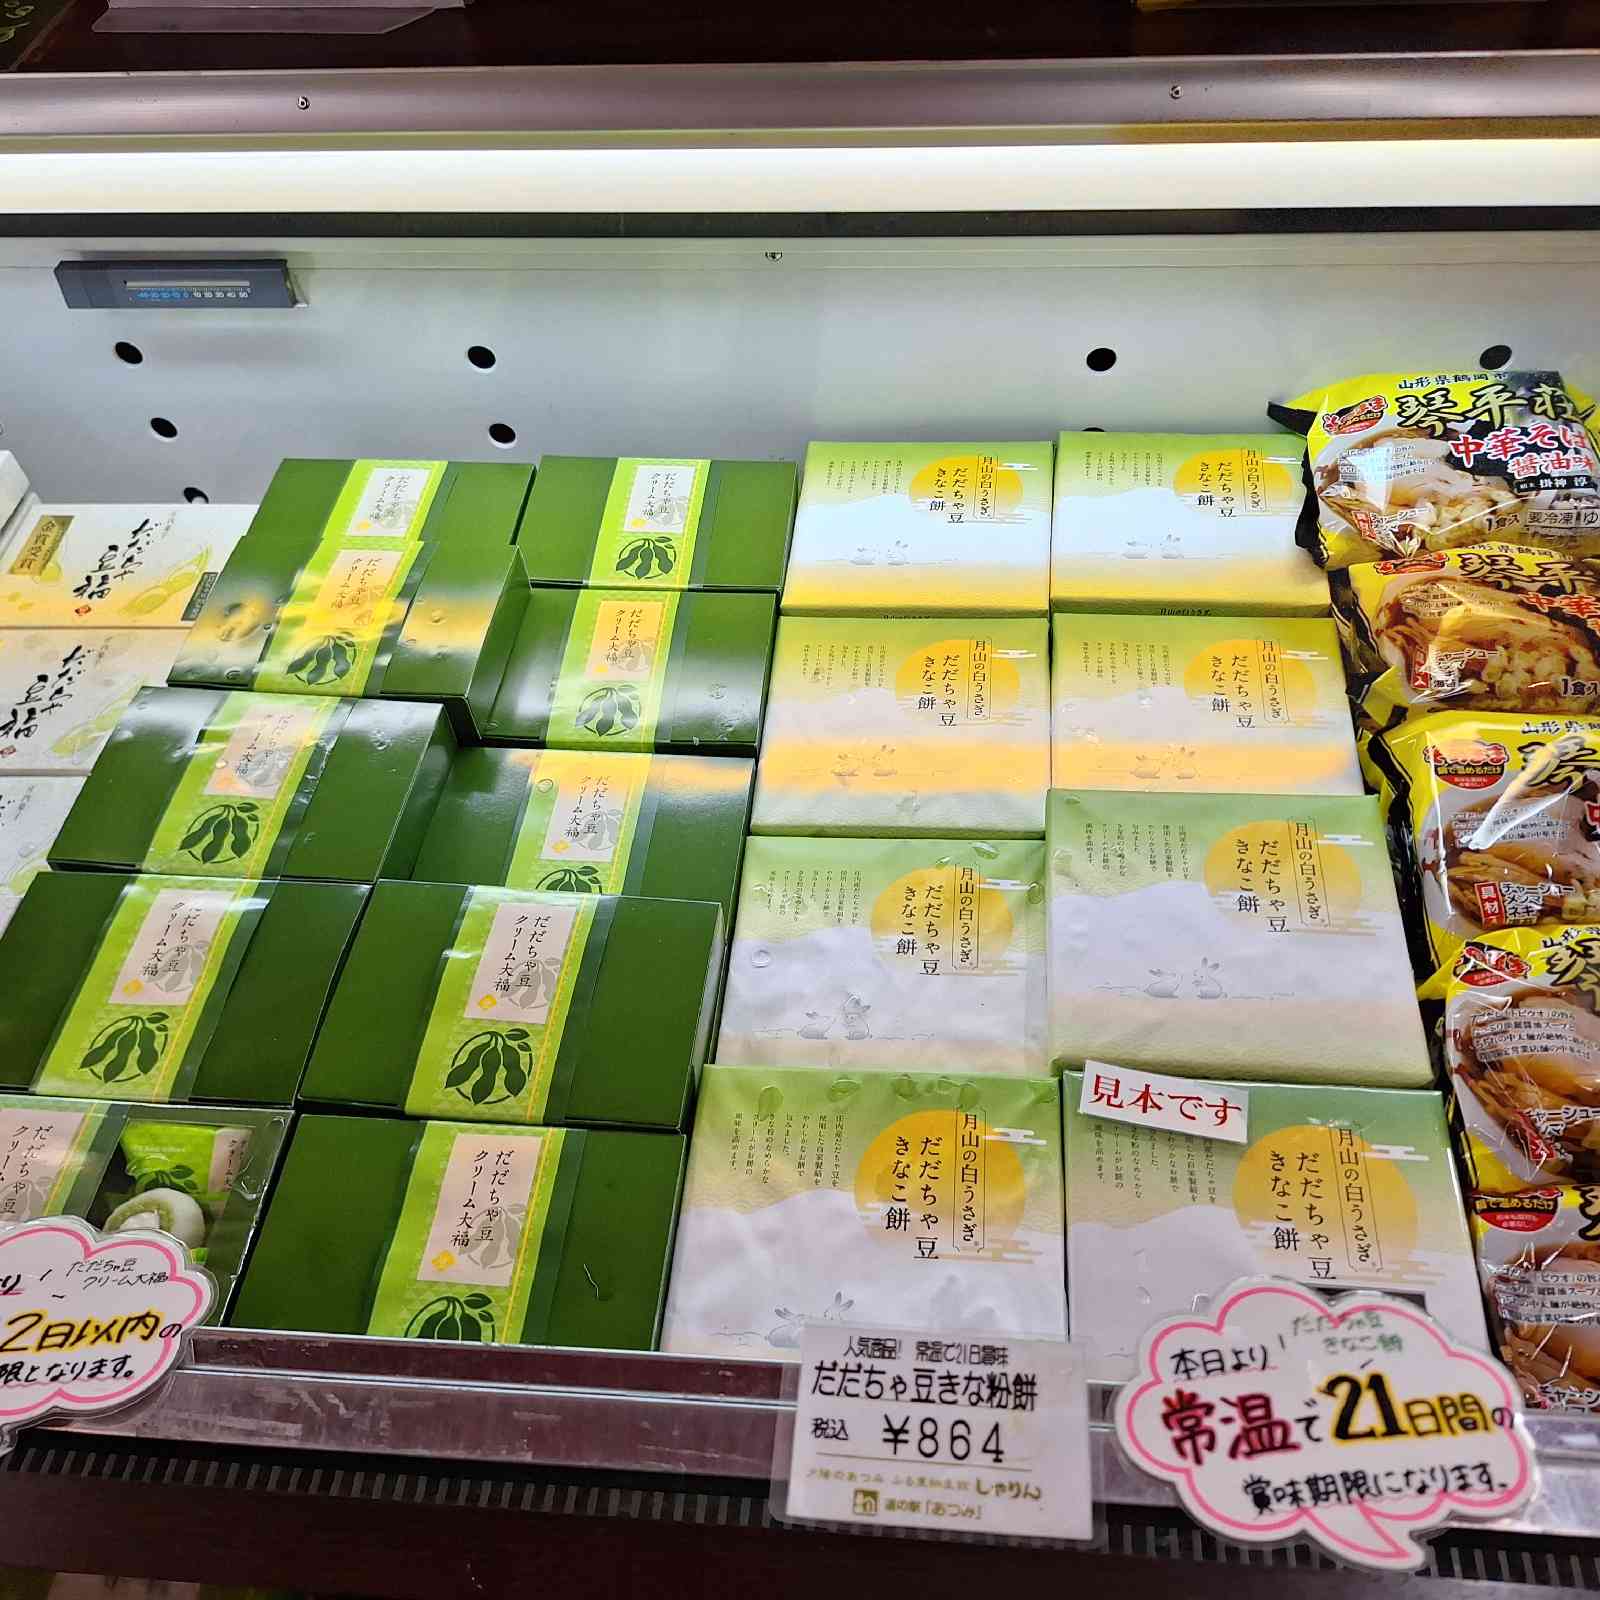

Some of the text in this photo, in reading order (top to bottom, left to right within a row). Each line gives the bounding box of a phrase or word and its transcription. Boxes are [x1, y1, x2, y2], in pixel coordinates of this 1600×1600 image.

[1450, 422, 1590, 468] 中華そば
[1508, 450, 1594, 479] 醤油味
[917, 655, 938, 711] きなこ餅
[938, 653, 961, 727] だだちゃ豆
[971, 639, 988, 718] 月山の白うさぎ
[1209, 655, 1232, 714] きなこ餅
[1231, 654, 1257, 729] だだちゃ豆
[1262, 639, 1283, 720] 月山の白うさぎ
[1561, 677, 1599, 697] 1食入
[1235, 840, 1260, 914] きなこ餅
[1258, 839, 1291, 934] だだちゃ豆
[1294, 821, 1321, 921] 月山の白うさぎ
[494, 914, 529, 992] クリーム大福
[513, 914, 552, 988] だだちゃ豆
[895, 885, 919, 957] きなこ餅
[919, 884, 946, 976] だだちゃ豆
[957, 865, 976, 964] 月山の白うさぎ
[1088, 1073, 1243, 1128] 見本です
[1, 1125, 54, 1214] だだちゃ豆
[450, 1149, 490, 1248] クリーム大福
[475, 1149, 515, 1242] だだちゃ豆
[884, 1135, 911, 1233] きなこ餅
[913, 1136, 944, 1261] だだちゃ豆
[960, 1112, 981, 1243] 月山の白うさぎ
[1269, 1150, 1301, 1252] きなこ餅
[1337, 1128, 1371, 1264] 月山の白うさぎ
[1297, 1151, 1338, 1281] だだちゃ豆
[0, 1311, 182, 1352] 2日以内の
[1170, 1345, 1270, 1380] 本日より
[811, 1359, 1038, 1412] だだちゃ豆きな粉餅
[1160, 1373, 1514, 1467] 常温で21日間の
[811, 1413, 1005, 1464] 税込 ¥864
[975, 1476, 1043, 1501] しゃりん
